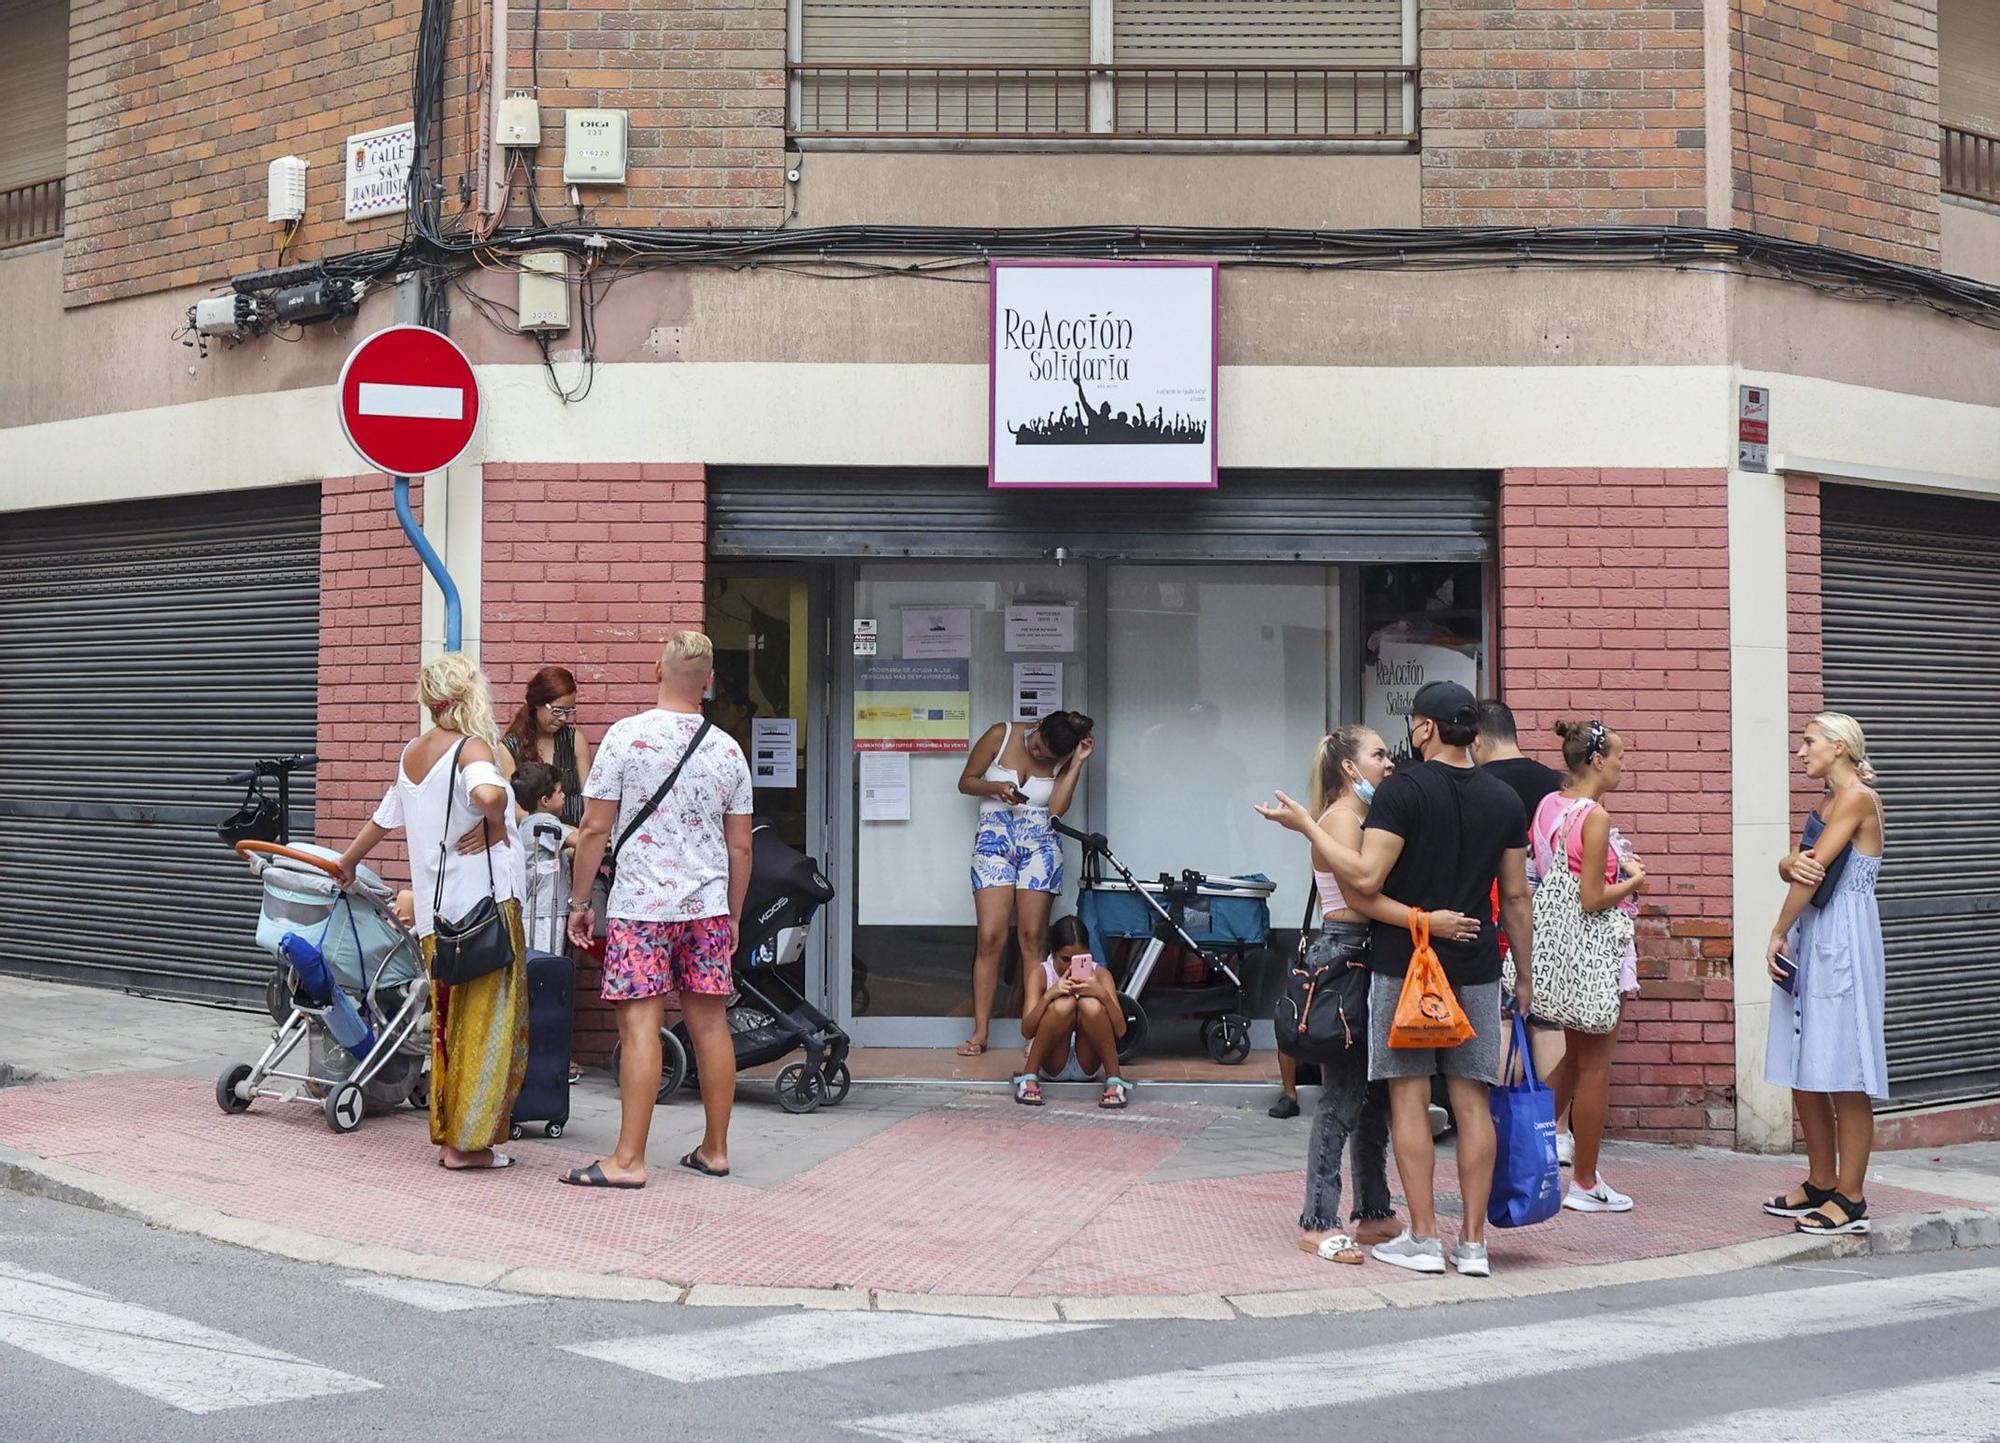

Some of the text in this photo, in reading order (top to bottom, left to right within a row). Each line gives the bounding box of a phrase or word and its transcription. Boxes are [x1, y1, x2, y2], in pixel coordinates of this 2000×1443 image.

[371, 143, 405, 165] CALLE
[379, 163, 400, 180] SAN
[352, 184, 371, 201] JUAN
[1004, 308, 1133, 350] ReAcción
[1029, 351, 1129, 381] Solidaria
[1375, 657, 1424, 685] ReAcción
[758, 897, 789, 924] KOOS
